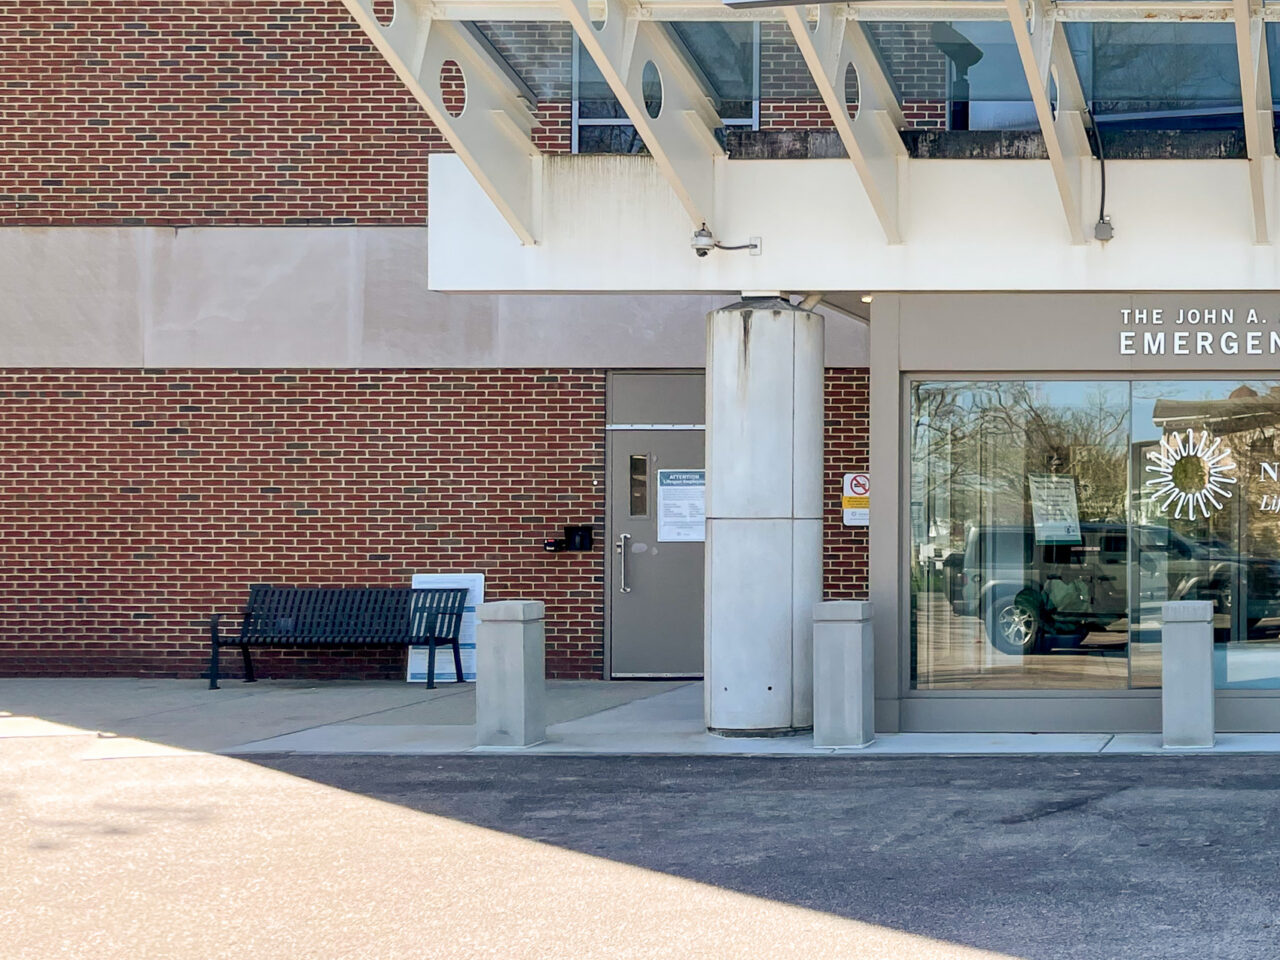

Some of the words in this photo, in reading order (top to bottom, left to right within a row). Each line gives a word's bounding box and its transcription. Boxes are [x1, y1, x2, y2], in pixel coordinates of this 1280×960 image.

[1120, 309, 1164, 325] THE
[1175, 309, 1234, 325] JOHN
[1246, 309, 1267, 325] A.
